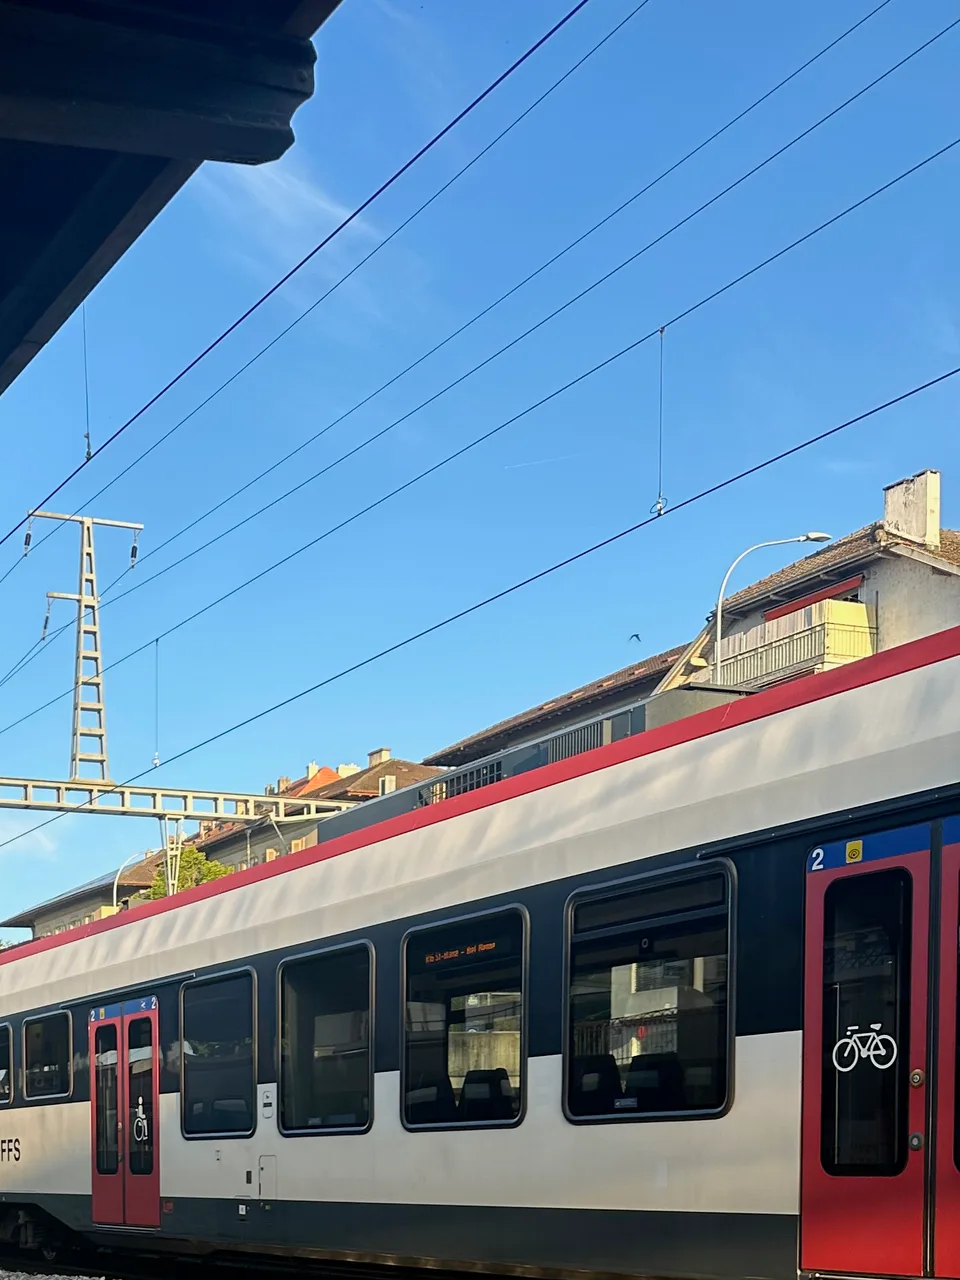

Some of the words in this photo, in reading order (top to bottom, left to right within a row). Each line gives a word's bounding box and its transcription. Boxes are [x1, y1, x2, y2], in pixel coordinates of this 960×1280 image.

[811, 848, 824, 871] 2
[151, 996, 157, 1009] 2
[0, 1138, 21, 1162] FFS
